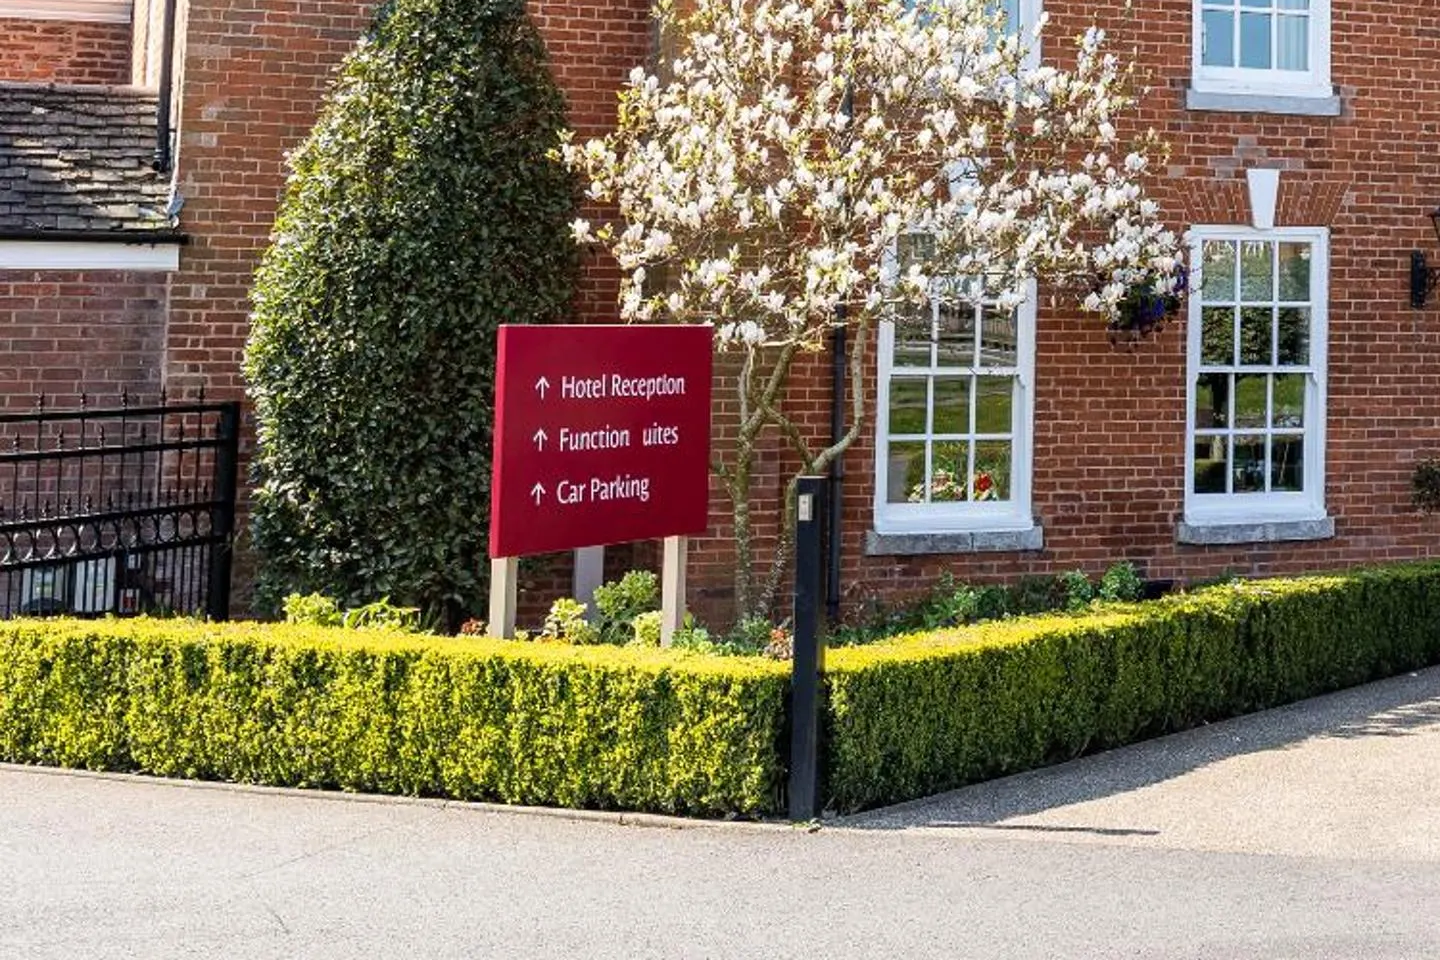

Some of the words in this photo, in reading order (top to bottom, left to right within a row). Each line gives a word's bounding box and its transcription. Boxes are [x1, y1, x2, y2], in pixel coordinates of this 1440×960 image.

[561, 374, 606, 399] Hotel
[611, 373, 686, 401] Reception
[559, 424, 630, 452] Function
[556, 479, 586, 504] Car
[590, 474, 650, 502] Parking
